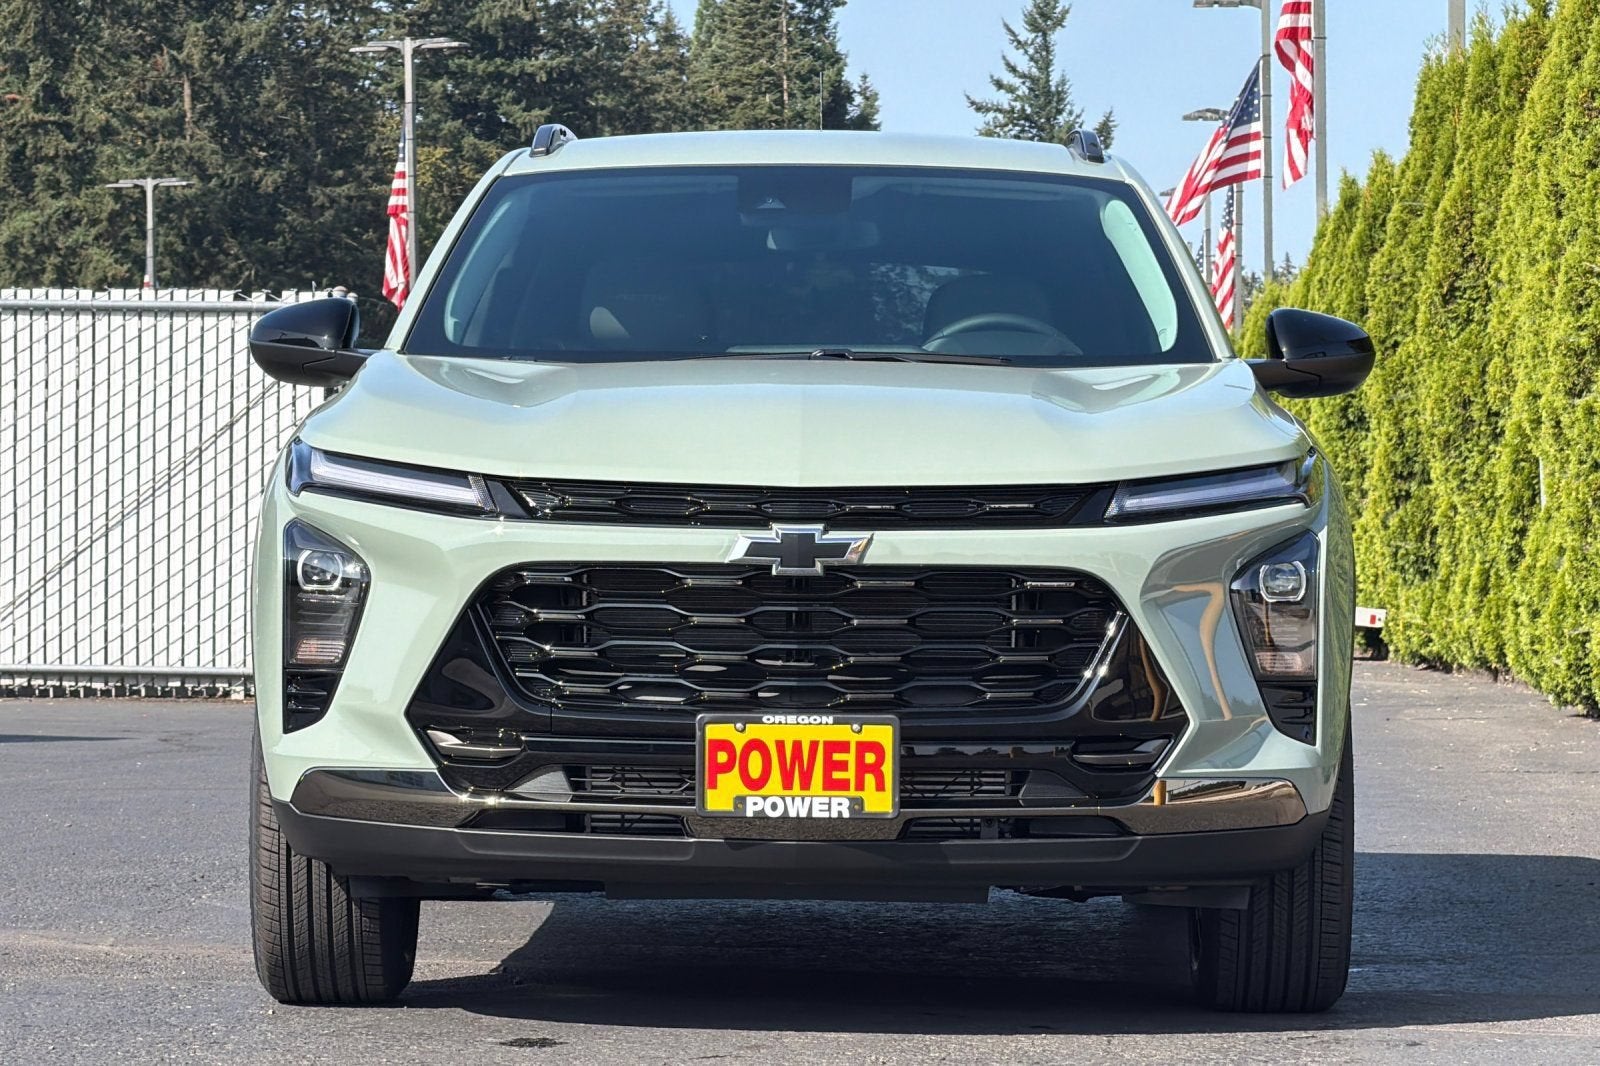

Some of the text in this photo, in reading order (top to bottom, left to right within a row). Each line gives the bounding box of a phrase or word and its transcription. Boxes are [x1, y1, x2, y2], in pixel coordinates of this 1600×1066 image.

[762, 715, 834, 725] OREGON
[707, 738, 886, 792] POWER
[746, 796, 850, 818] POWER
